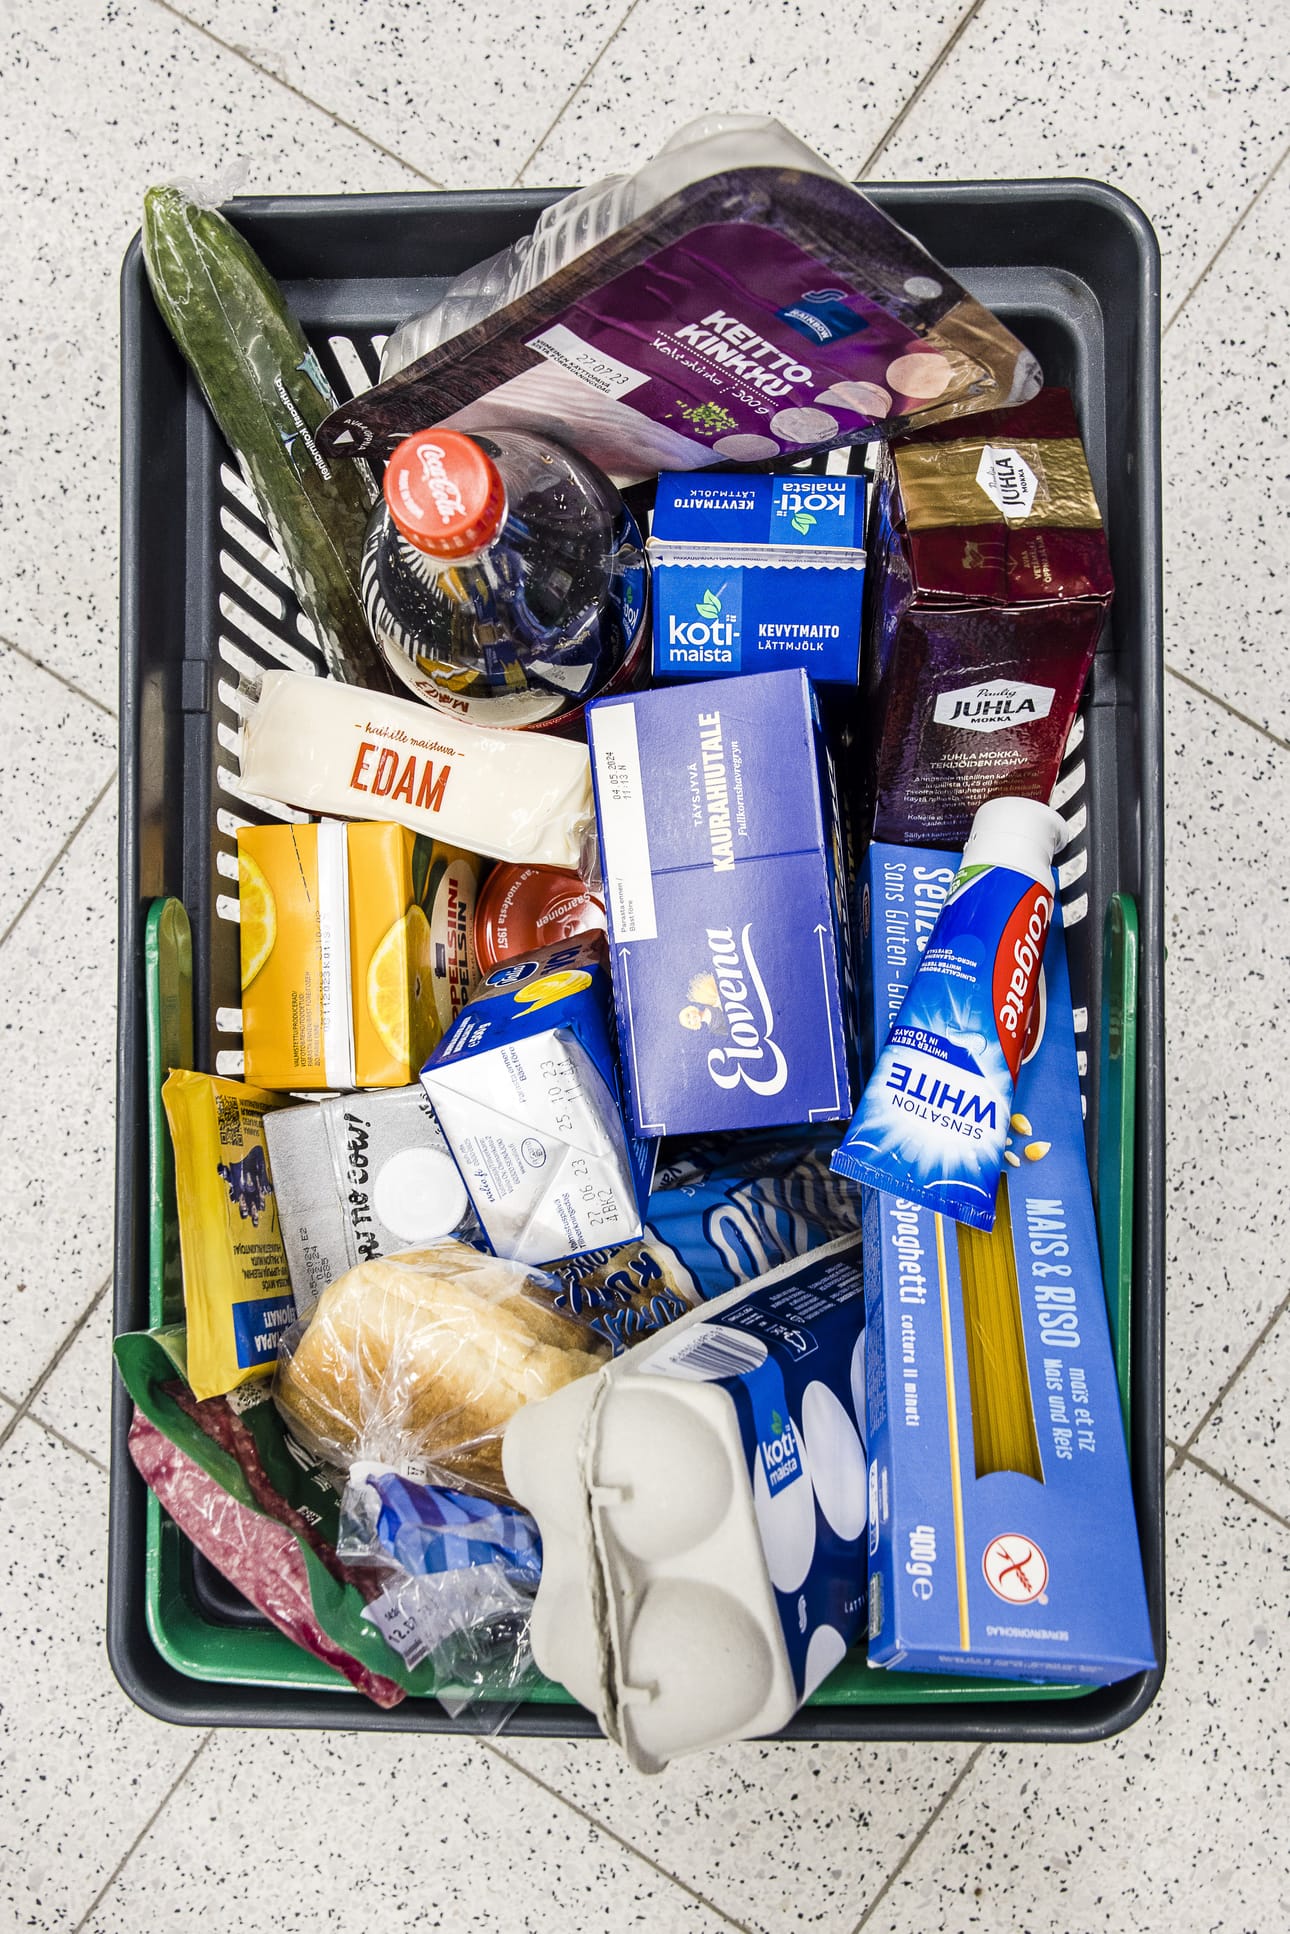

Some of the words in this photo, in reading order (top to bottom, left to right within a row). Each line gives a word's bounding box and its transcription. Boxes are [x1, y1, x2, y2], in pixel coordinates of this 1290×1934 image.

[789, 308, 833, 341] RAINBOW
[674, 323, 793, 397] KINKKU
[700, 309, 815, 388] KEITTO-
[416, 443, 468, 525] Coca-Cola
[690, 489, 756, 498] LÄTTMJÖLK
[782, 482, 847, 493] maista
[994, 456, 1026, 506] JUHLA
[1018, 469, 1029, 494] MOKKA
[674, 498, 755, 511] KEVYTMAITO
[773, 493, 847, 516] koti-
[669, 614, 742, 646] koti-
[758, 623, 840, 639] KEVYTMAITO
[758, 640, 825, 651] LÄTTMJÖLK
[669, 645, 733, 663] maista
[976, 688, 1017, 699] Paulig
[949, 699, 1036, 721] JUHLA
[970, 716, 1012, 724] MOKKA
[930, 758, 993, 769] TEKIJÖIDEN
[940, 753, 977, 761] JUHLA
[350, 741, 452, 813] EDAM
[605, 751, 622, 800] 04.05.2024
[698, 710, 736, 872] KAURAHIUTALE
[731, 740, 748, 837] Fullkornshavregryn
[687, 762, 704, 827] TÄYSJYVÄ
[617, 882, 625, 905] ennen
[885, 862, 907, 902] Sans
[498, 880, 522, 925] vuodesta
[535, 891, 591, 929] Saarioinen
[617, 906, 627, 933] Parasta
[628, 916, 636, 932] Bäst
[497, 927, 509, 949] 1957
[885, 909, 910, 966] Gluten
[999, 894, 1050, 1032] Colgate
[705, 922, 788, 1097] Elovena
[890, 1036, 922, 1053] TEETH
[893, 1028, 914, 1039] DAYS
[915, 1031, 929, 1042] 10
[929, 1035, 939, 1046] IN
[921, 1040, 949, 1060] WHITER
[885, 1062, 997, 1130] WHITE
[891, 1093, 984, 1140] SENSATION
[597, 1187, 619, 1223] 4BK2
[1025, 1198, 1071, 1257] MAIS
[889, 1197, 927, 1305] Spaghetti
[1031, 1261, 1073, 1279] &
[1034, 1285, 1082, 1349] RISO
[901, 1315, 917, 1364] cottura
[1043, 1358, 1065, 1392] Mais
[1068, 1367, 1089, 1404] maïs
[903, 1383, 920, 1428] minuti
[1048, 1394, 1071, 1425] und
[1074, 1408, 1092, 1426] et
[761, 1427, 797, 1470] koti-
[1052, 1427, 1074, 1461] Reis
[1078, 1429, 1097, 1454] riz
[769, 1457, 798, 1487] maista
